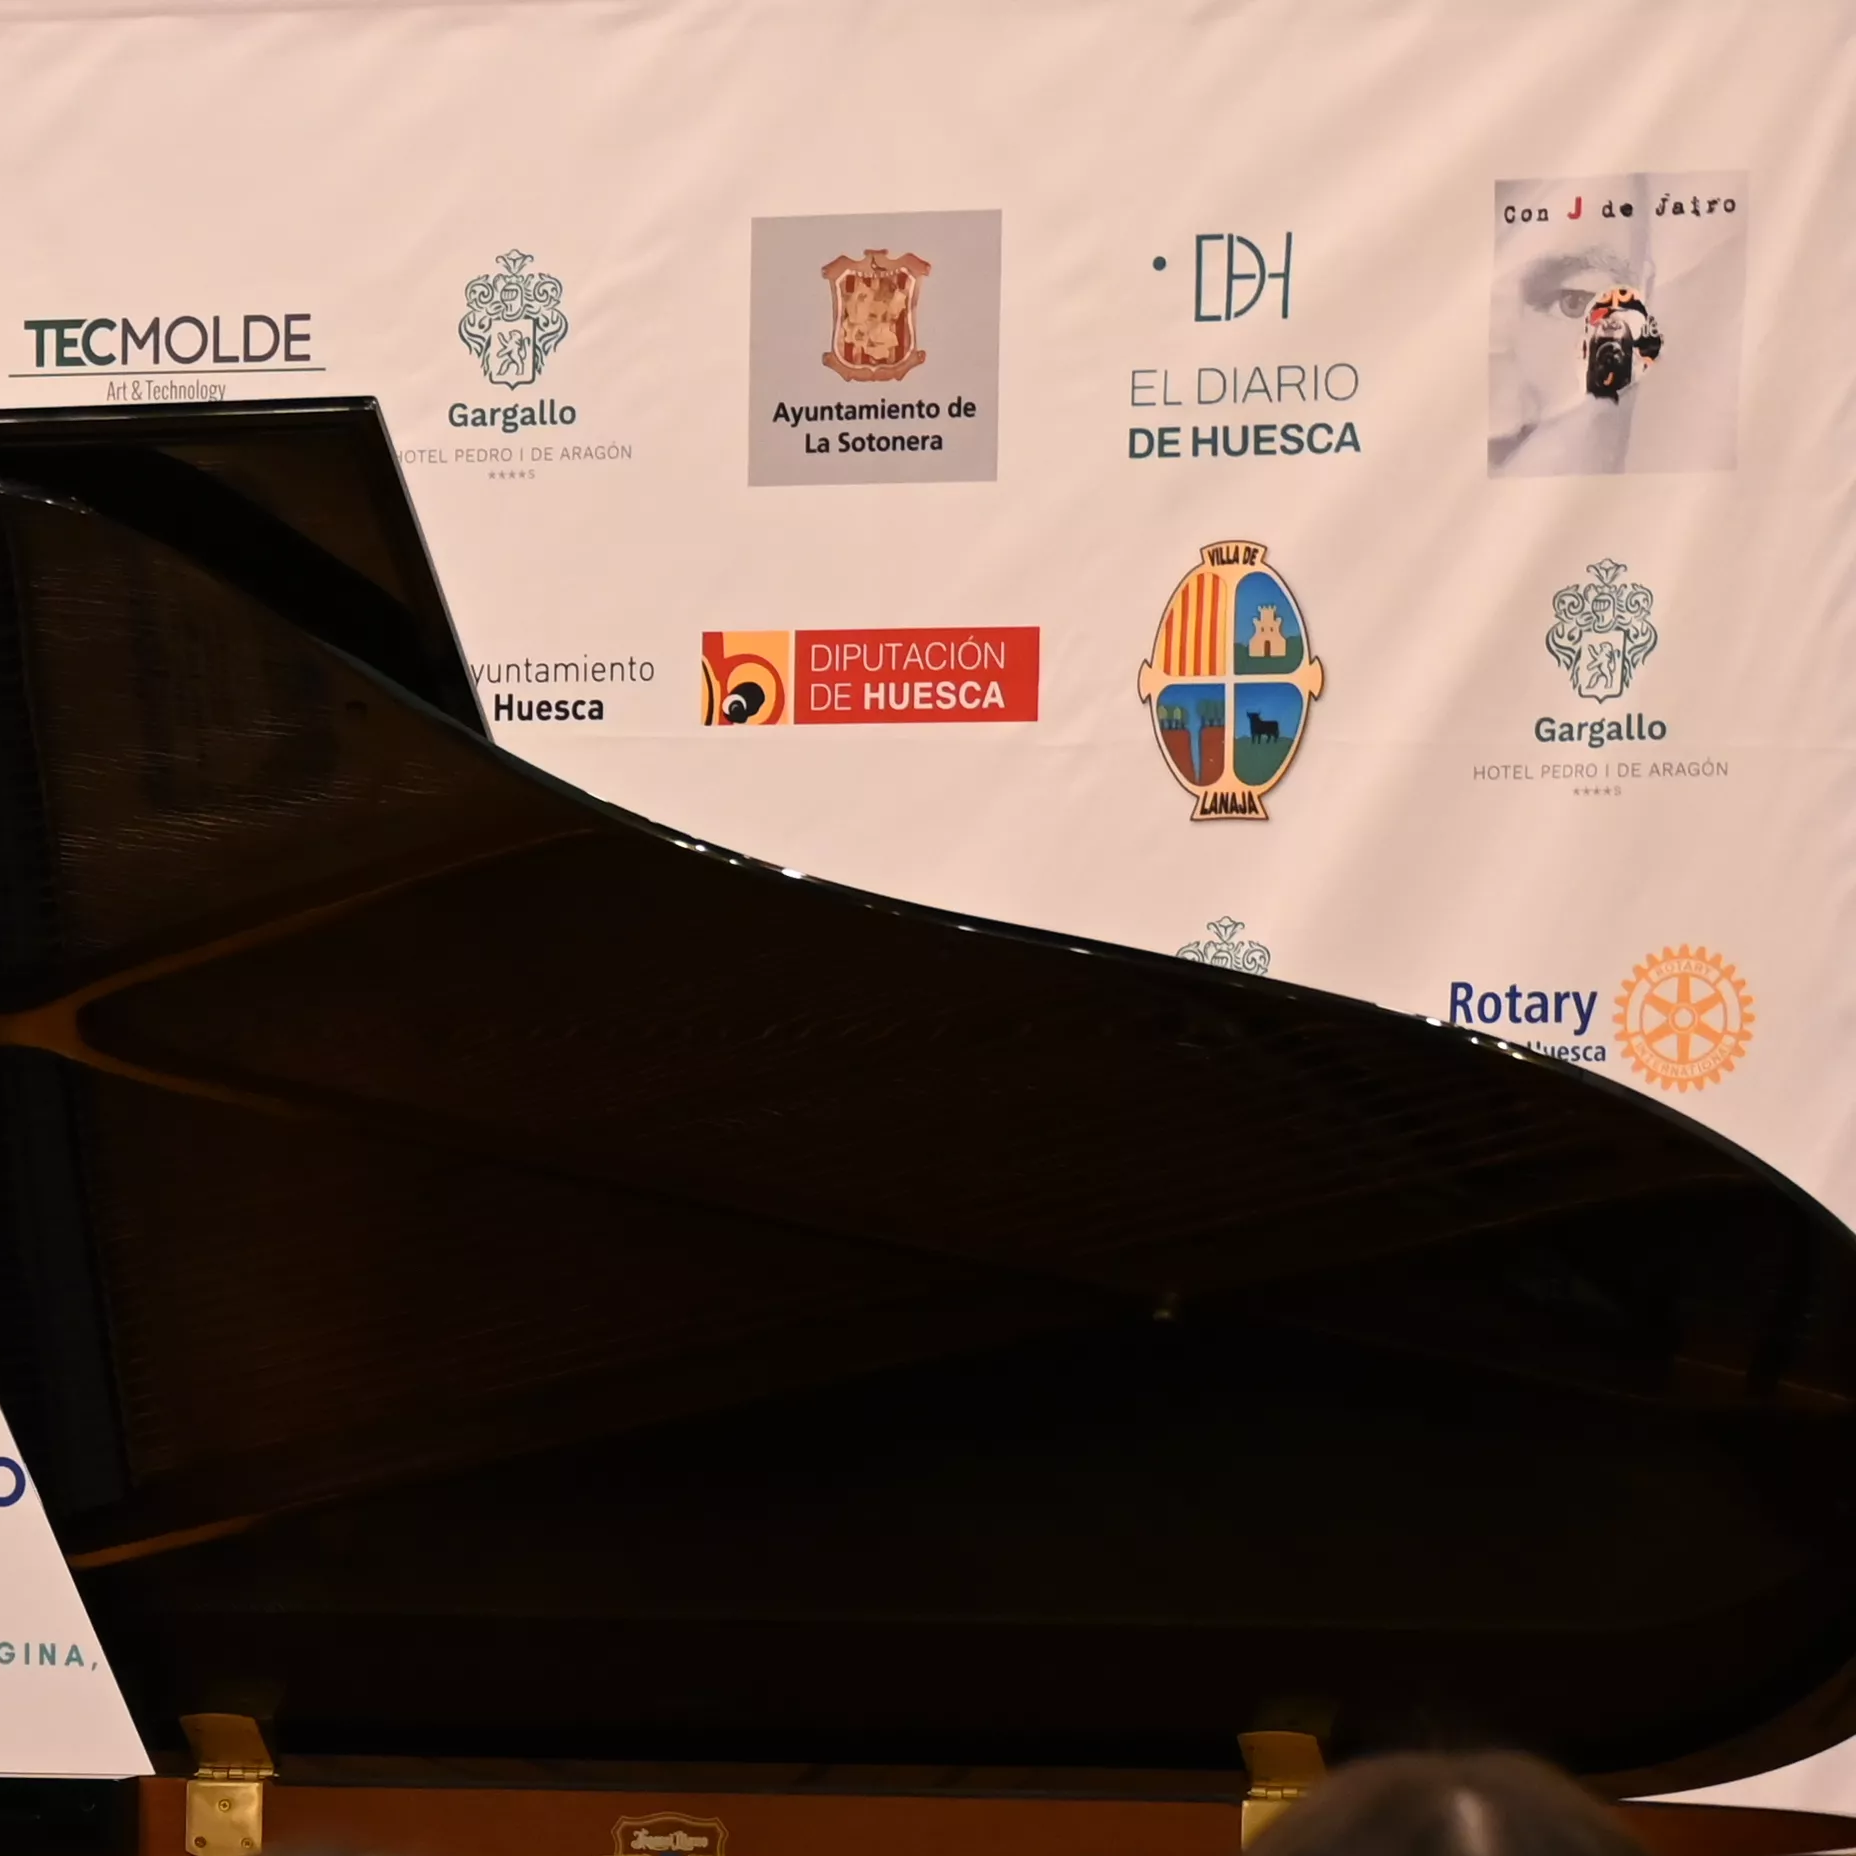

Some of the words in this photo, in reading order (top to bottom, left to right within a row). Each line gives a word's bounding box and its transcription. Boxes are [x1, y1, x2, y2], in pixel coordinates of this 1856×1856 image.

[1504, 206, 1548, 224] Con
[1567, 196, 1582, 220] J
[1602, 200, 1633, 218] de
[24, 314, 311, 367] TECMOLDE
[106, 379, 128, 402] Art
[131, 380, 143, 401] &
[145, 377, 227, 402] Technology
[1131, 370, 1182, 407] EL
[1198, 363, 1358, 404] DIARIO
[449, 399, 576, 433] Gargallo
[773, 398, 940, 427] Ayuntamiento
[948, 396, 976, 418] de
[455, 448, 512, 462] PEDRO
[531, 447, 553, 461] DE
[560, 441, 631, 460] ARAGÓN
[806, 433, 829, 453] La
[838, 432, 942, 452] Sotonera
[1129, 427, 1180, 458] DE
[1192, 422, 1360, 457] HUESCA
[1208, 547, 1241, 568] VILLA
[1241, 547, 1260, 567] DE
[811, 636, 1004, 671] DIPUTACIÓN
[471, 654, 655, 686] yuntamiento
[495, 694, 603, 721] Huesca
[811, 683, 851, 710] DE
[865, 681, 1004, 710] HUESCA
[1535, 713, 1666, 748] Gargallo
[1474, 765, 1533, 780] HOTEL
[1541, 763, 1597, 779] PEDRO
[1618, 763, 1641, 778] DE
[1649, 757, 1728, 777] ARAGÓN
[1199, 791, 1259, 818] LANAJA
[1654, 960, 1712, 977] ROTARY
[1449, 982, 1598, 1036] Rotary
